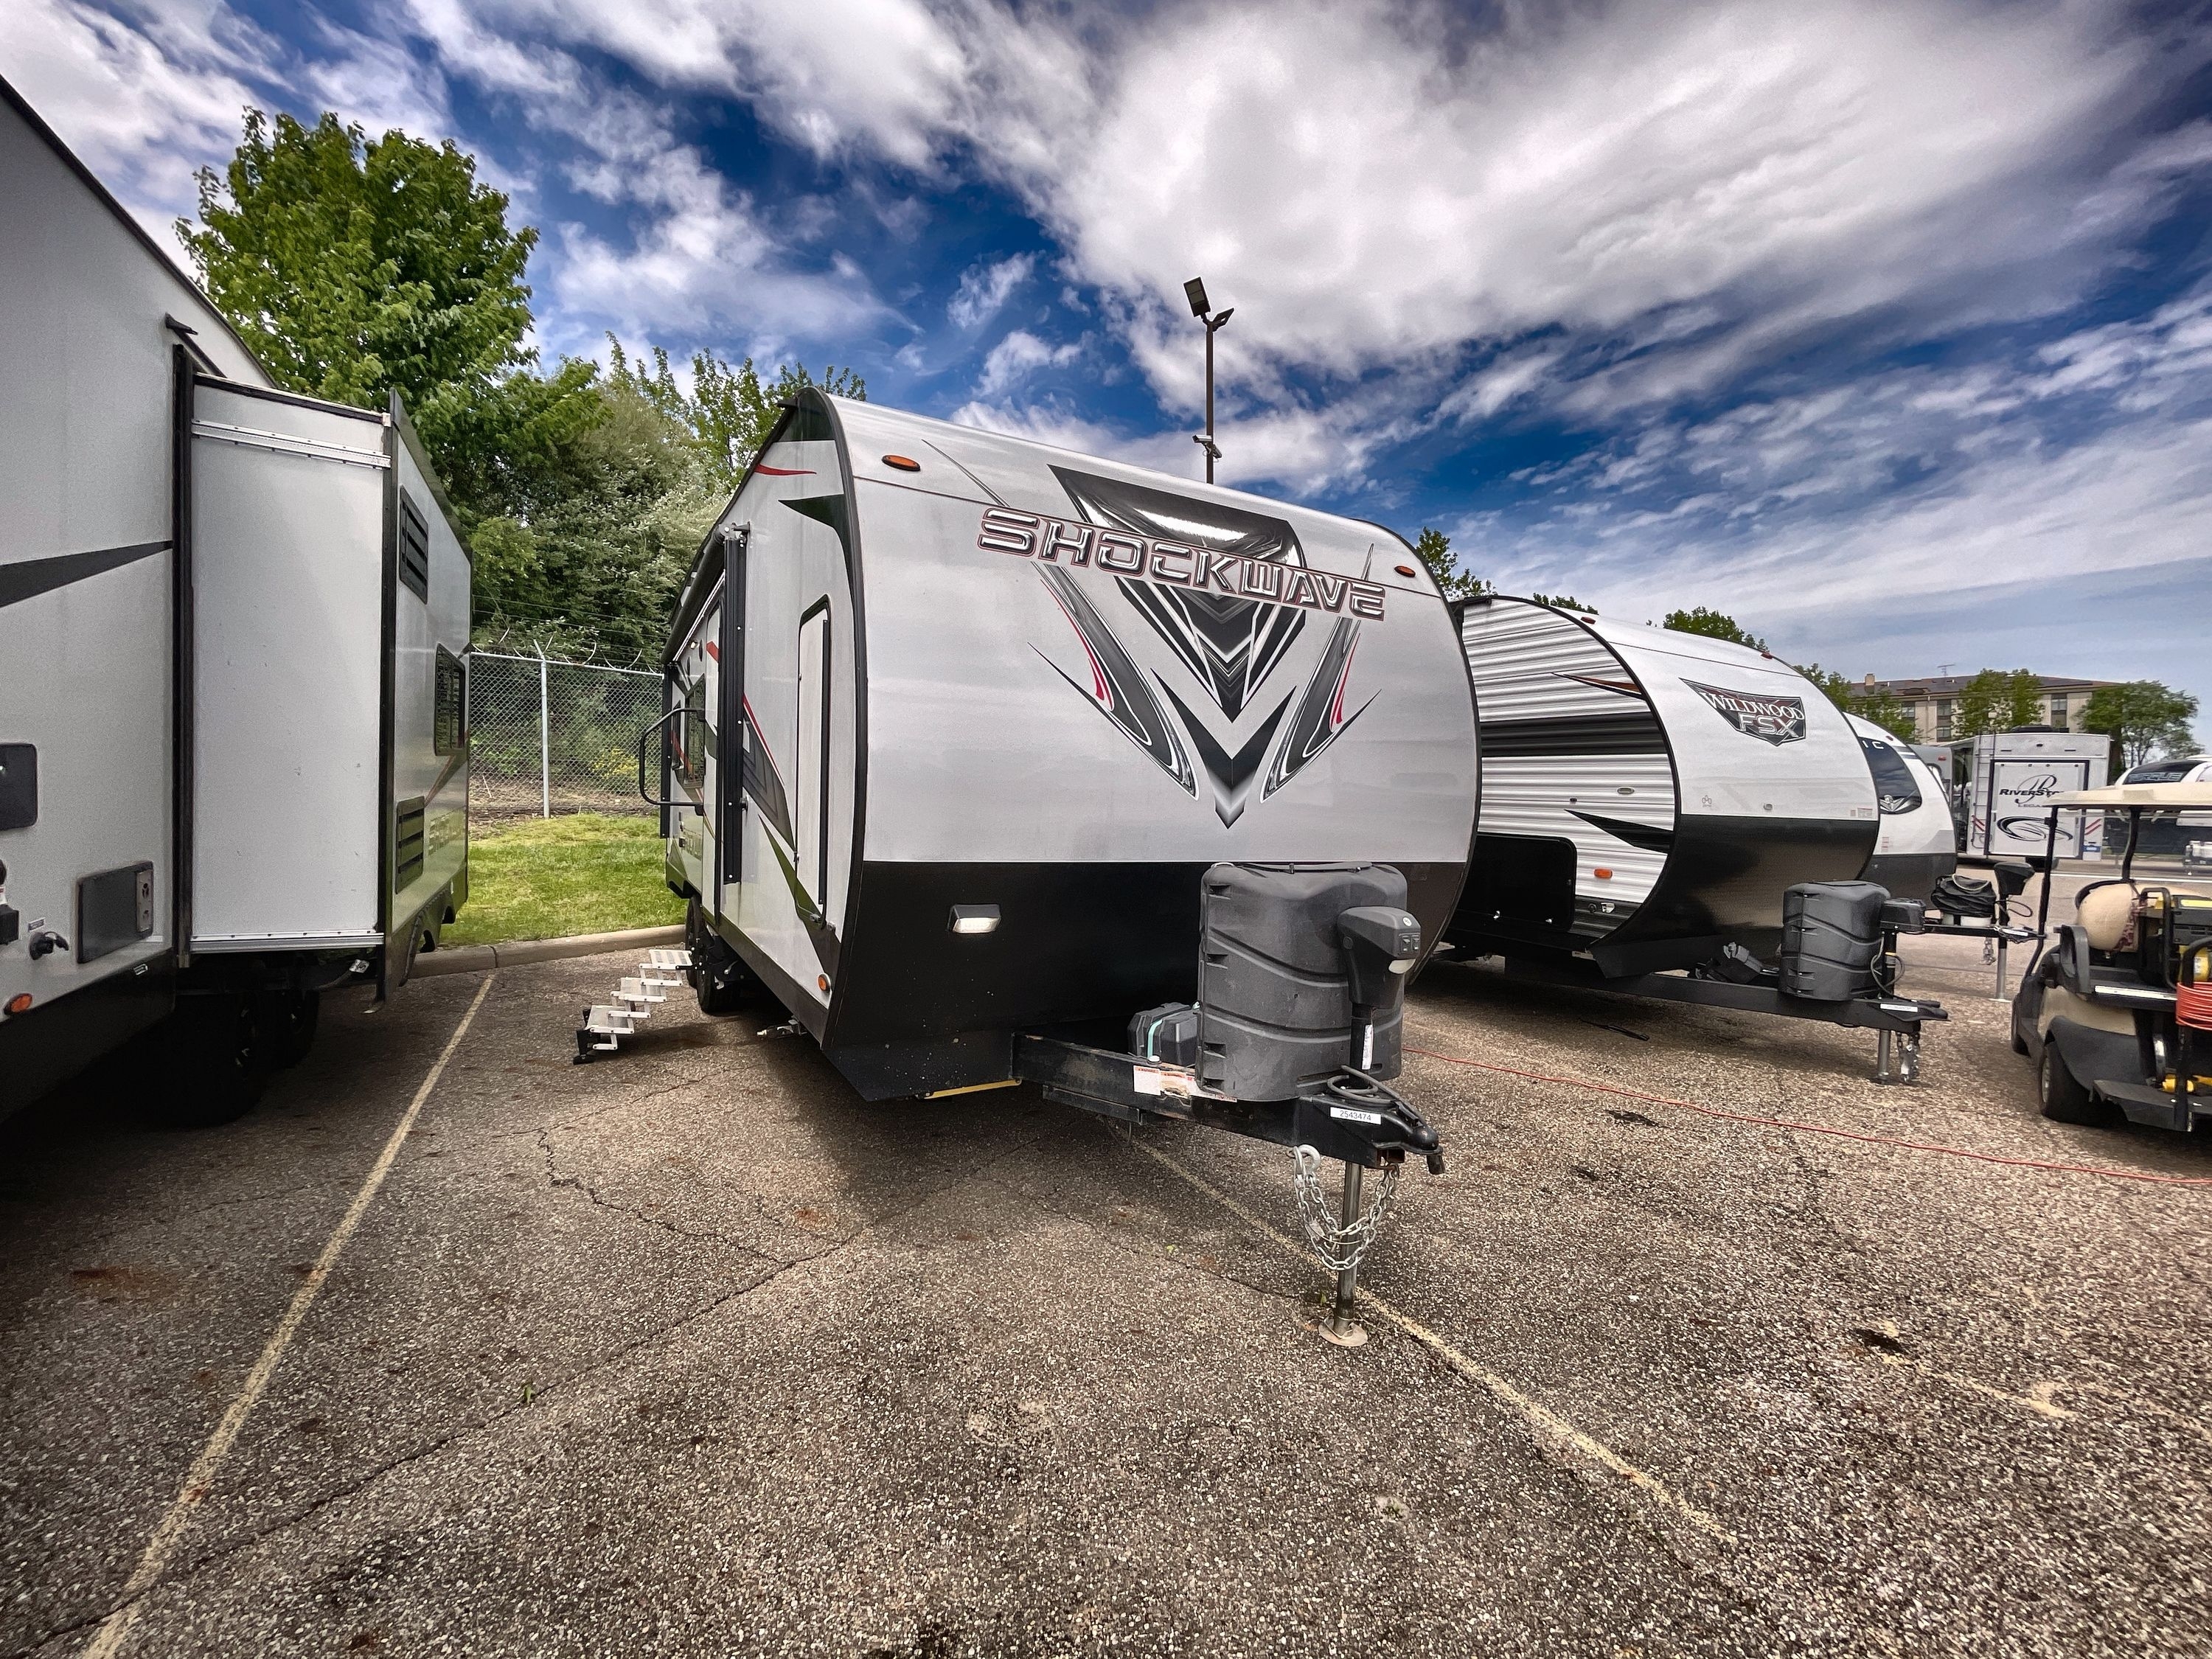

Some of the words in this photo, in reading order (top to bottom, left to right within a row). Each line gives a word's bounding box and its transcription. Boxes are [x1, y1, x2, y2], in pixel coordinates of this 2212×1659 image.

[978, 507, 1385, 621] SHOCKWAVE
[1698, 692, 1805, 720] WILDWOOD
[1737, 712, 1799, 738] FSX
[1340, 1110, 1371, 1121] 2543474
